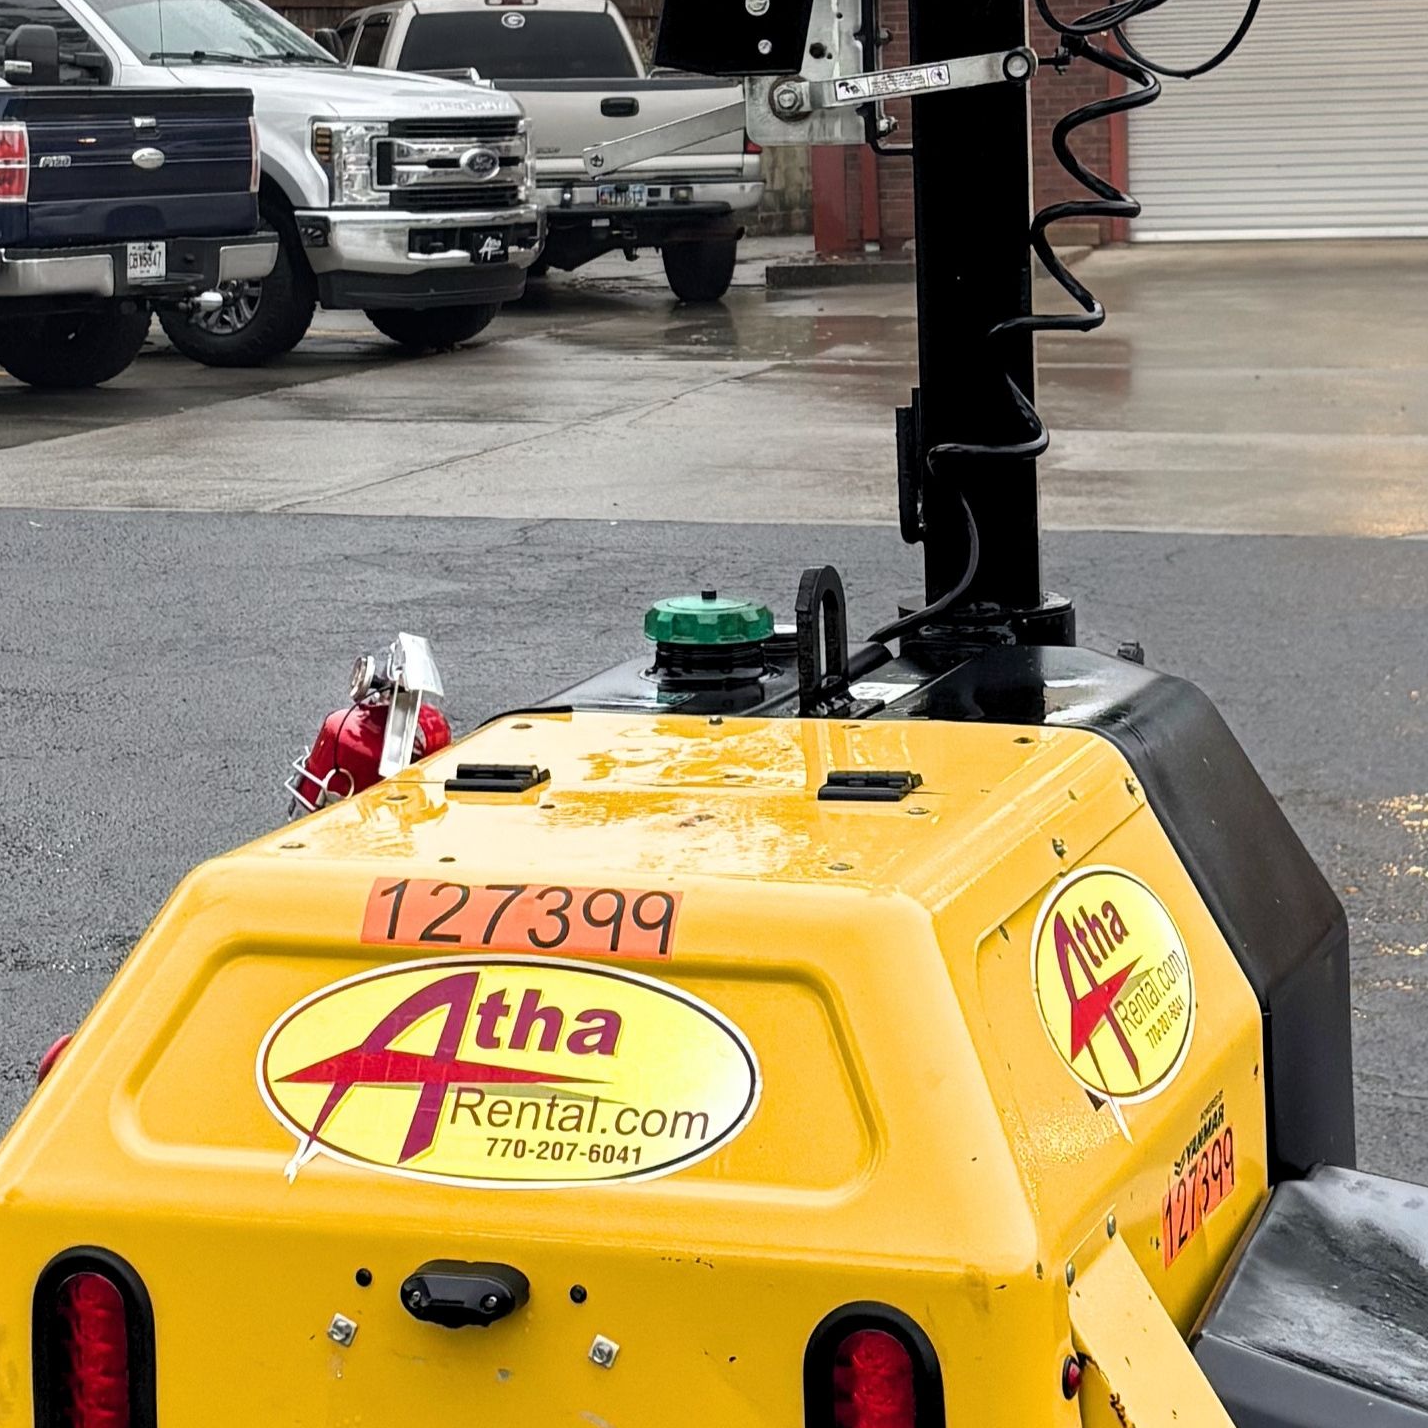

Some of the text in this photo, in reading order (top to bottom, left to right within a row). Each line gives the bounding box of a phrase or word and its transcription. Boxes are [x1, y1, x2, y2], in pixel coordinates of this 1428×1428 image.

[378, 878, 676, 956] 127399
[1053, 900, 1143, 1087] Atha
[1113, 950, 1186, 1037] Rental.com
[274, 970, 624, 1165] Atha
[449, 1086, 710, 1140] Rental.com
[485, 1137, 642, 1166] 770-207-6041
[1165, 1126, 1235, 1259] 127399
